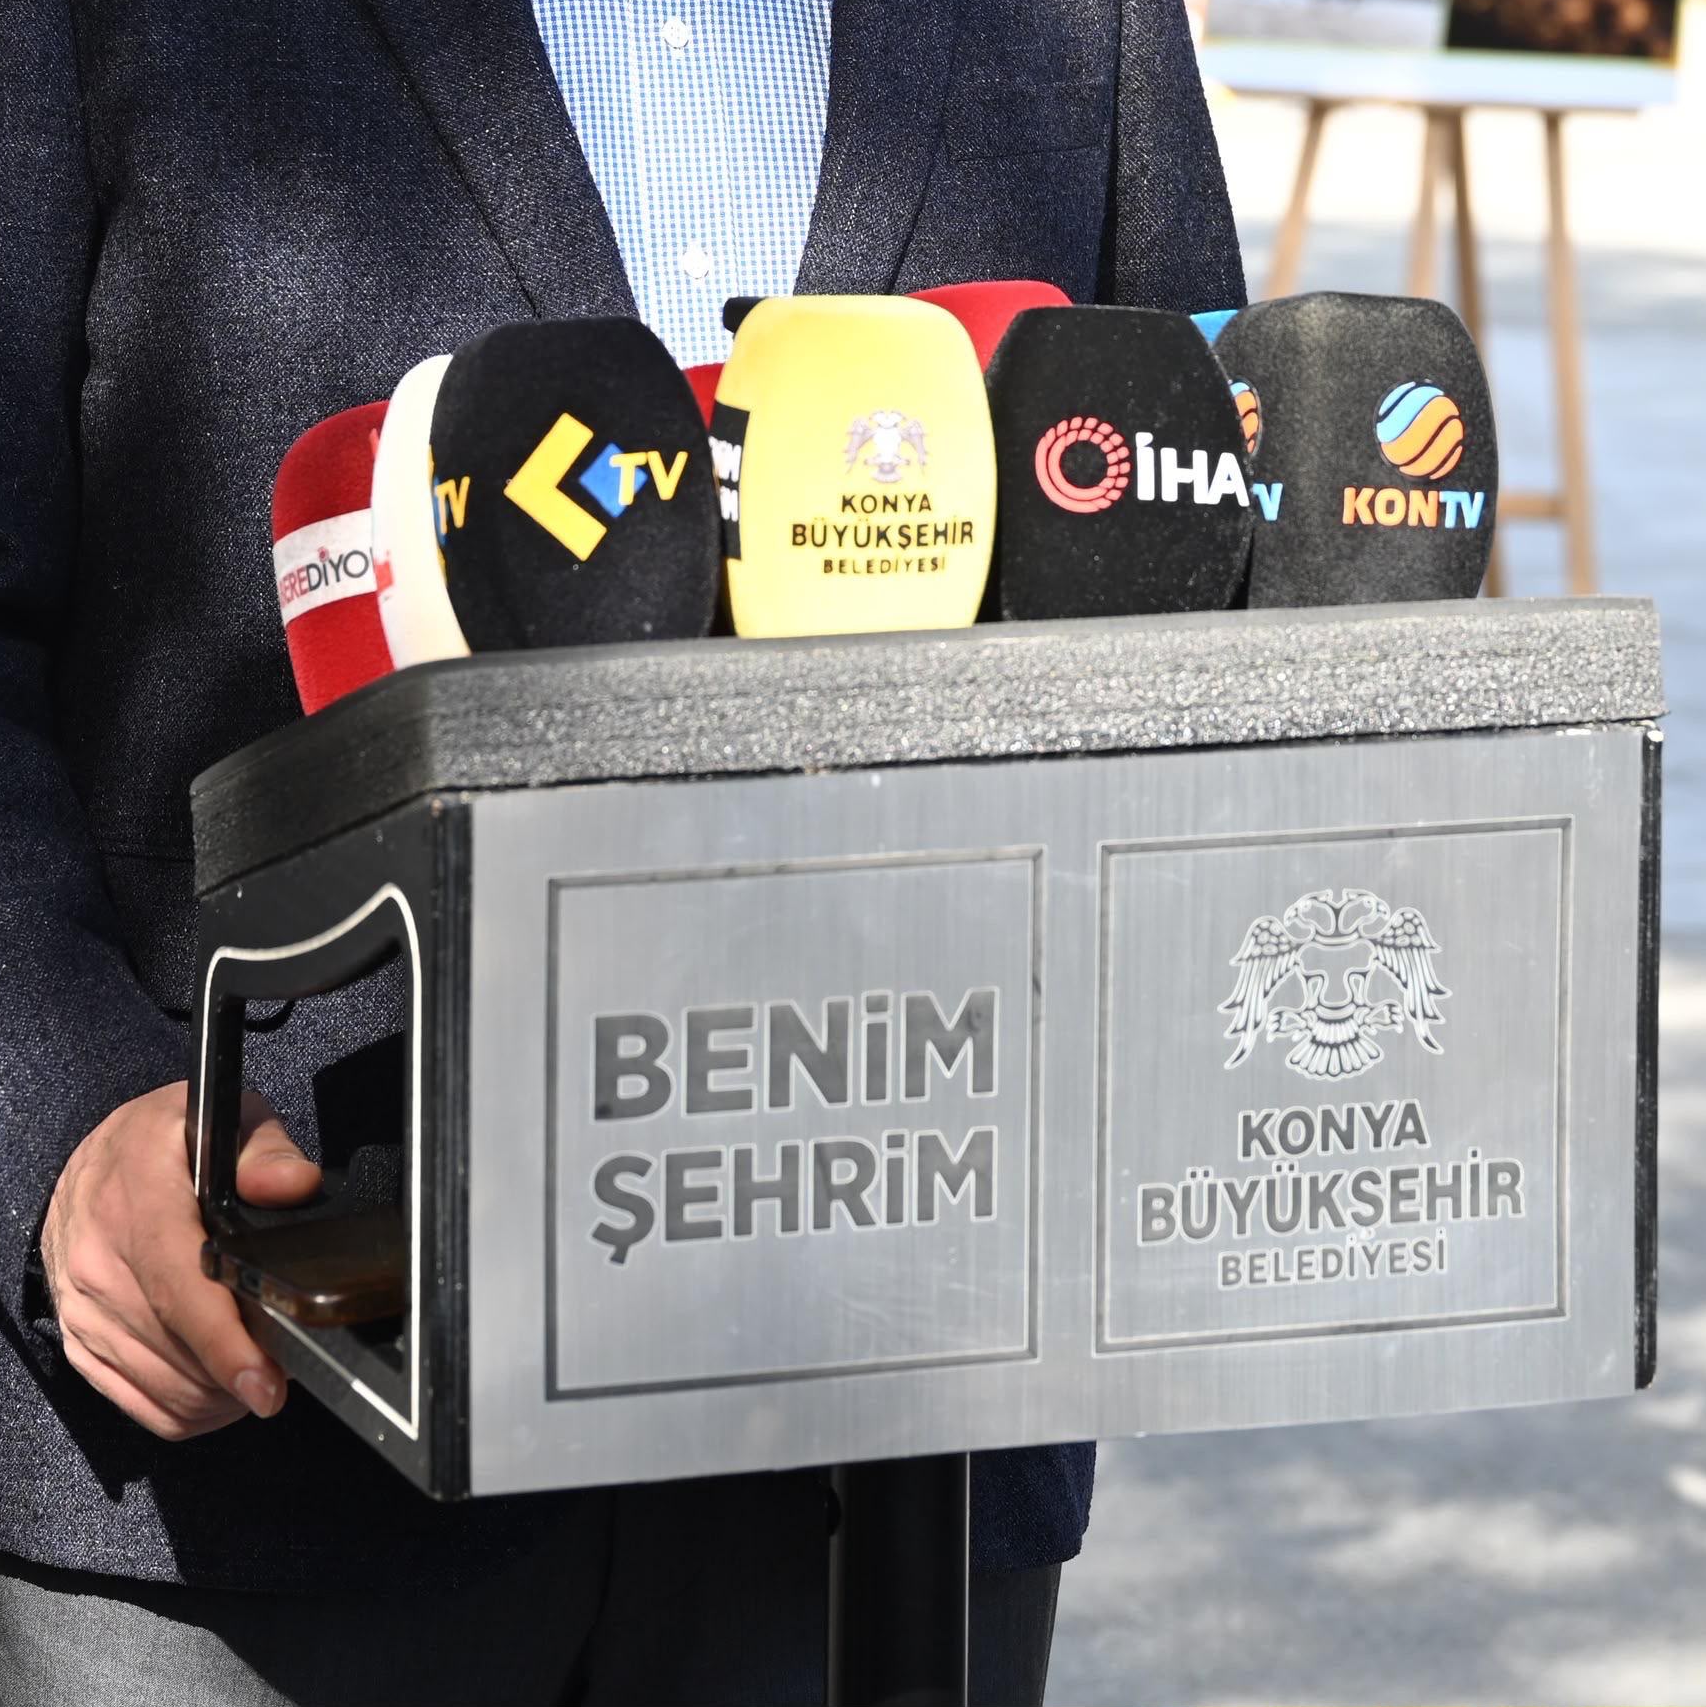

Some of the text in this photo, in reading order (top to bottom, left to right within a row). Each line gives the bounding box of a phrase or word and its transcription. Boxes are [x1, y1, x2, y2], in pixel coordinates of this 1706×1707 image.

[1135, 431, 1251, 507] İHA
[791, 516, 974, 550] BÜYÜKŞEHİR
[841, 493, 932, 514] KONYA
[1341, 486, 1485, 529] KONTV
[1239, 1099, 1428, 1161] KONYA
[1137, 1148, 1524, 1245] BÜYÜKŞEHİR
[1218, 1228, 1448, 1289] BELEDİYESİ
